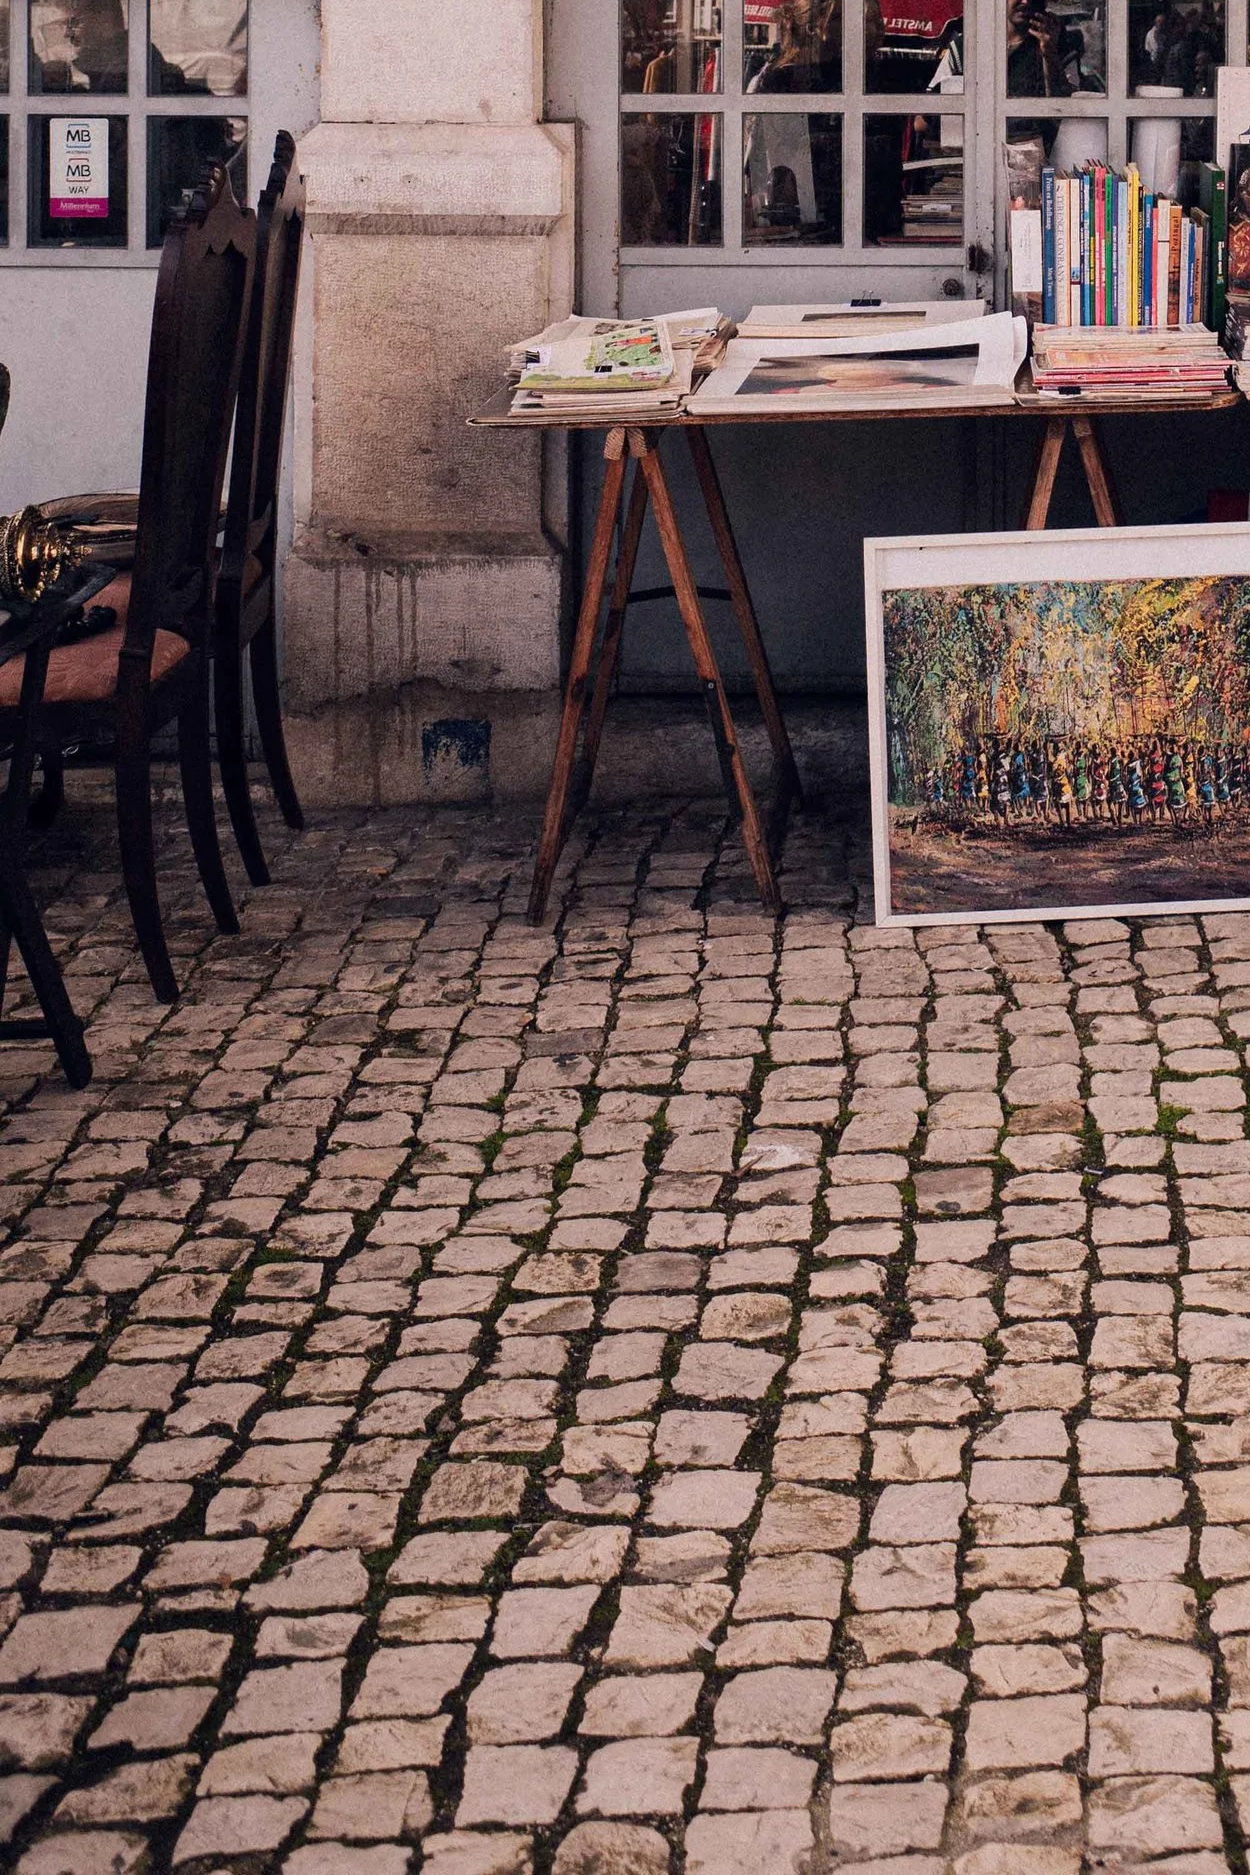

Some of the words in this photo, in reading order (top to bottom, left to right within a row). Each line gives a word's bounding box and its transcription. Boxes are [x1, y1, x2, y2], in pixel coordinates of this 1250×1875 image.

[66, 129, 91, 142] MB
[66, 164, 91, 177] MB
[68, 186, 89, 195] WAY
[1057, 195, 1065, 235] TERENCE
[1170, 215, 1179, 252] Portugal
